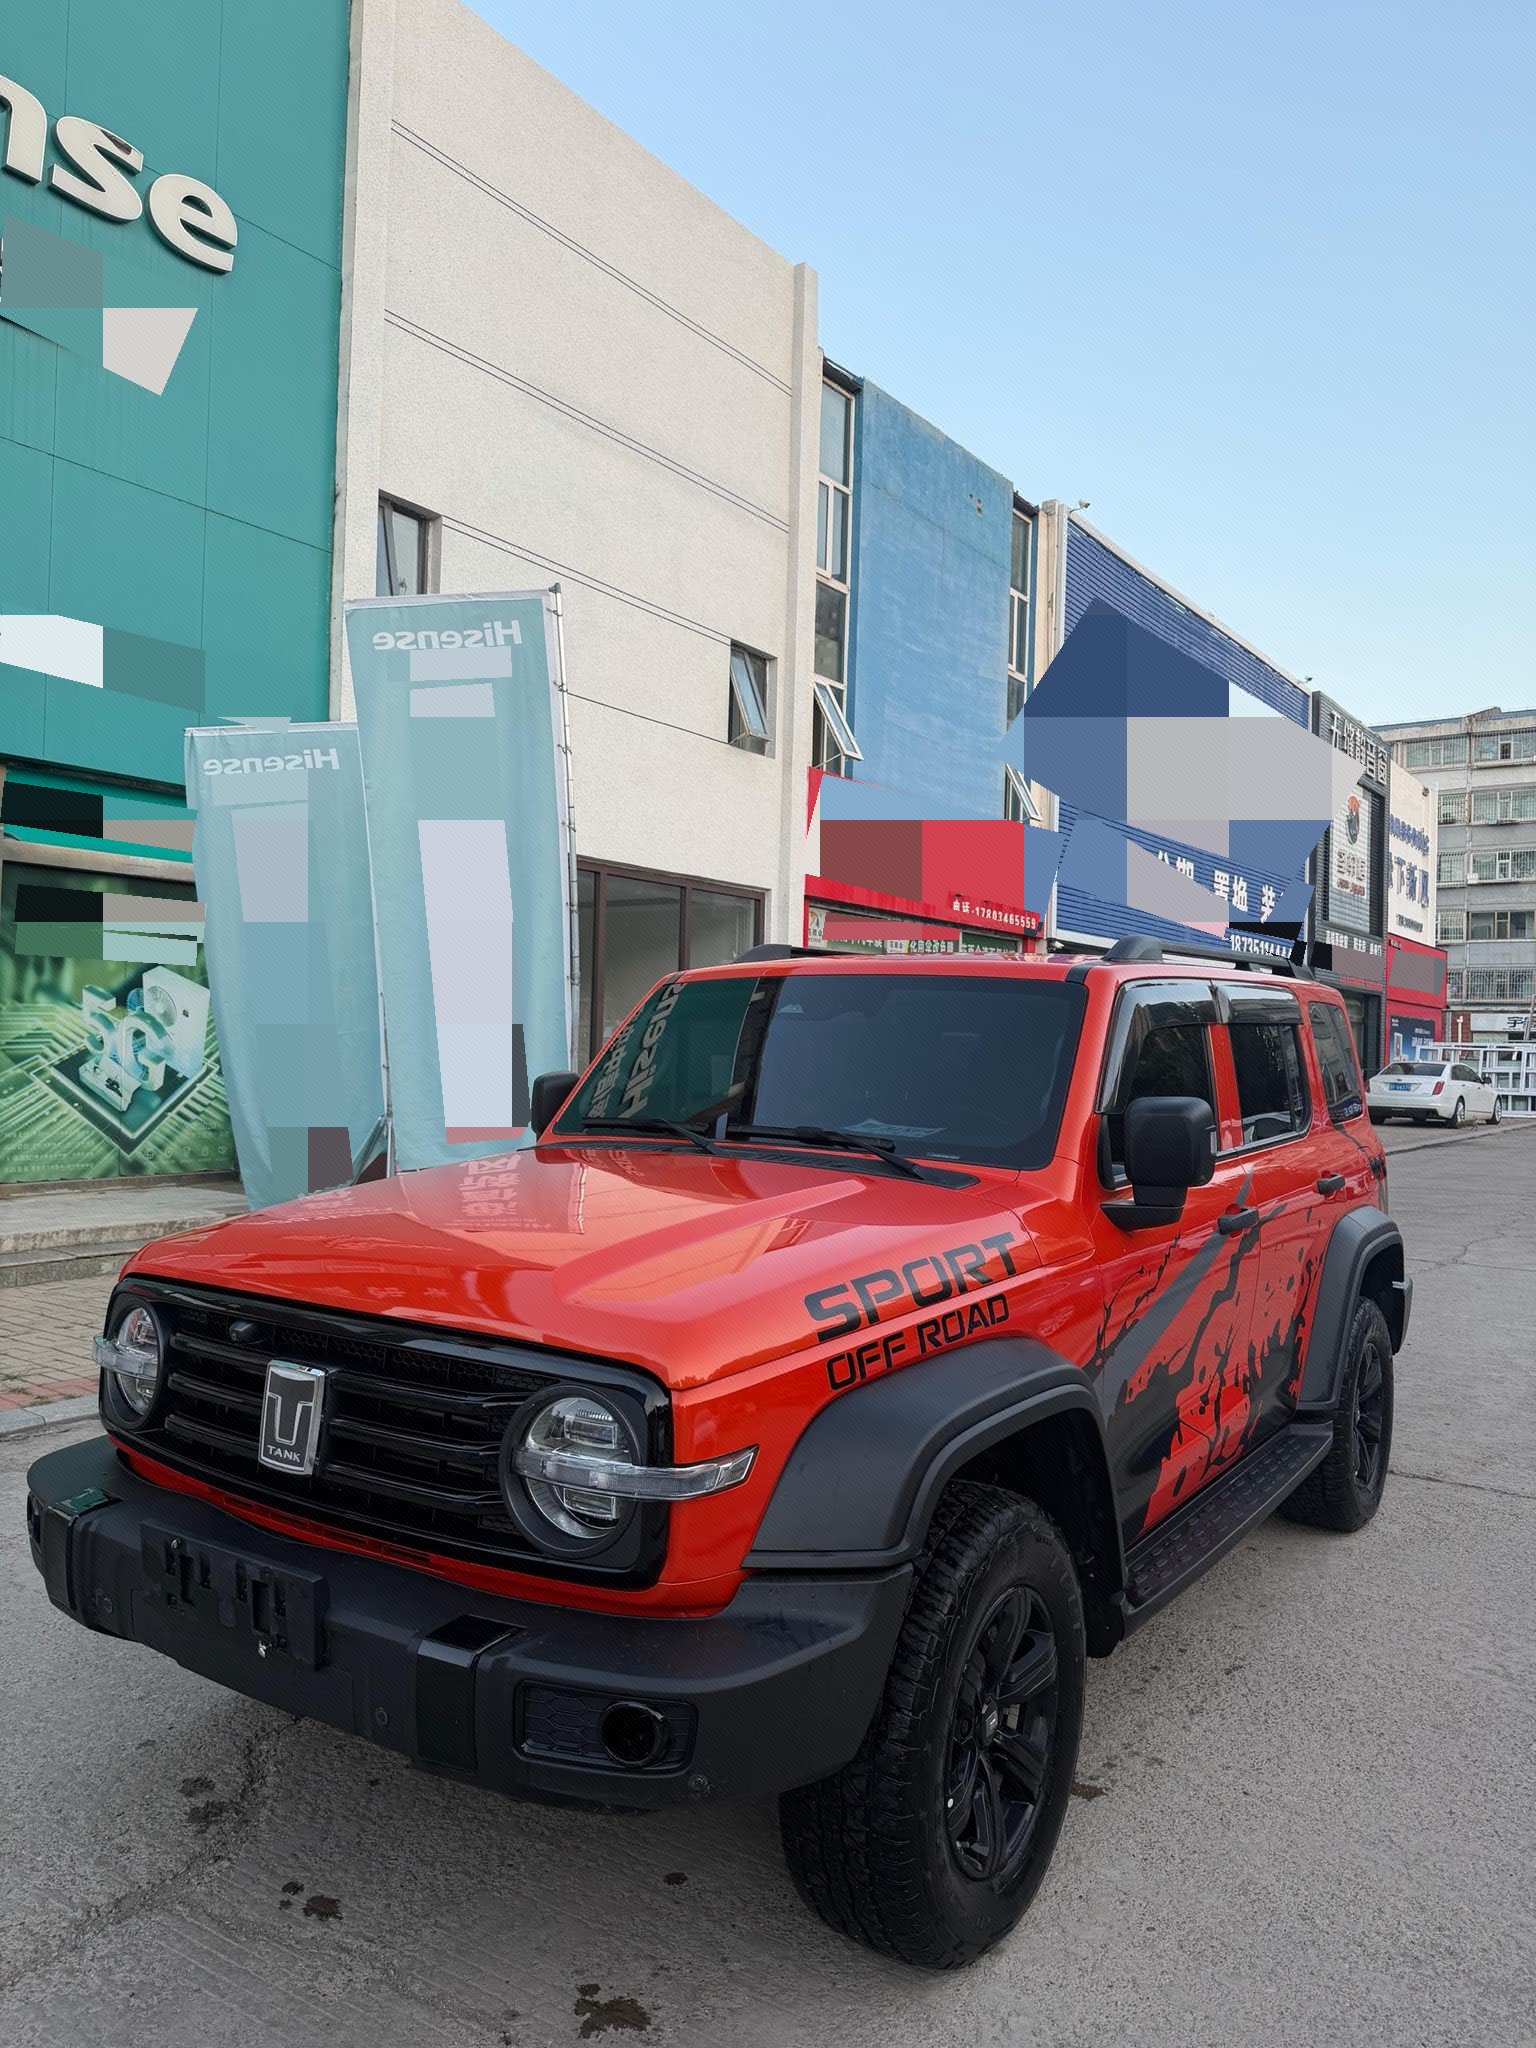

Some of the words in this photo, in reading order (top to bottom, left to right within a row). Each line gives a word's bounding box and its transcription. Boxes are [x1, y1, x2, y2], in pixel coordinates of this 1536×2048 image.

[803, 1231, 1018, 1343] SPORT
[826, 1332, 907, 1390] OFF
[916, 1294, 1010, 1355] ROAD
[267, 1444, 302, 1463] TANK
